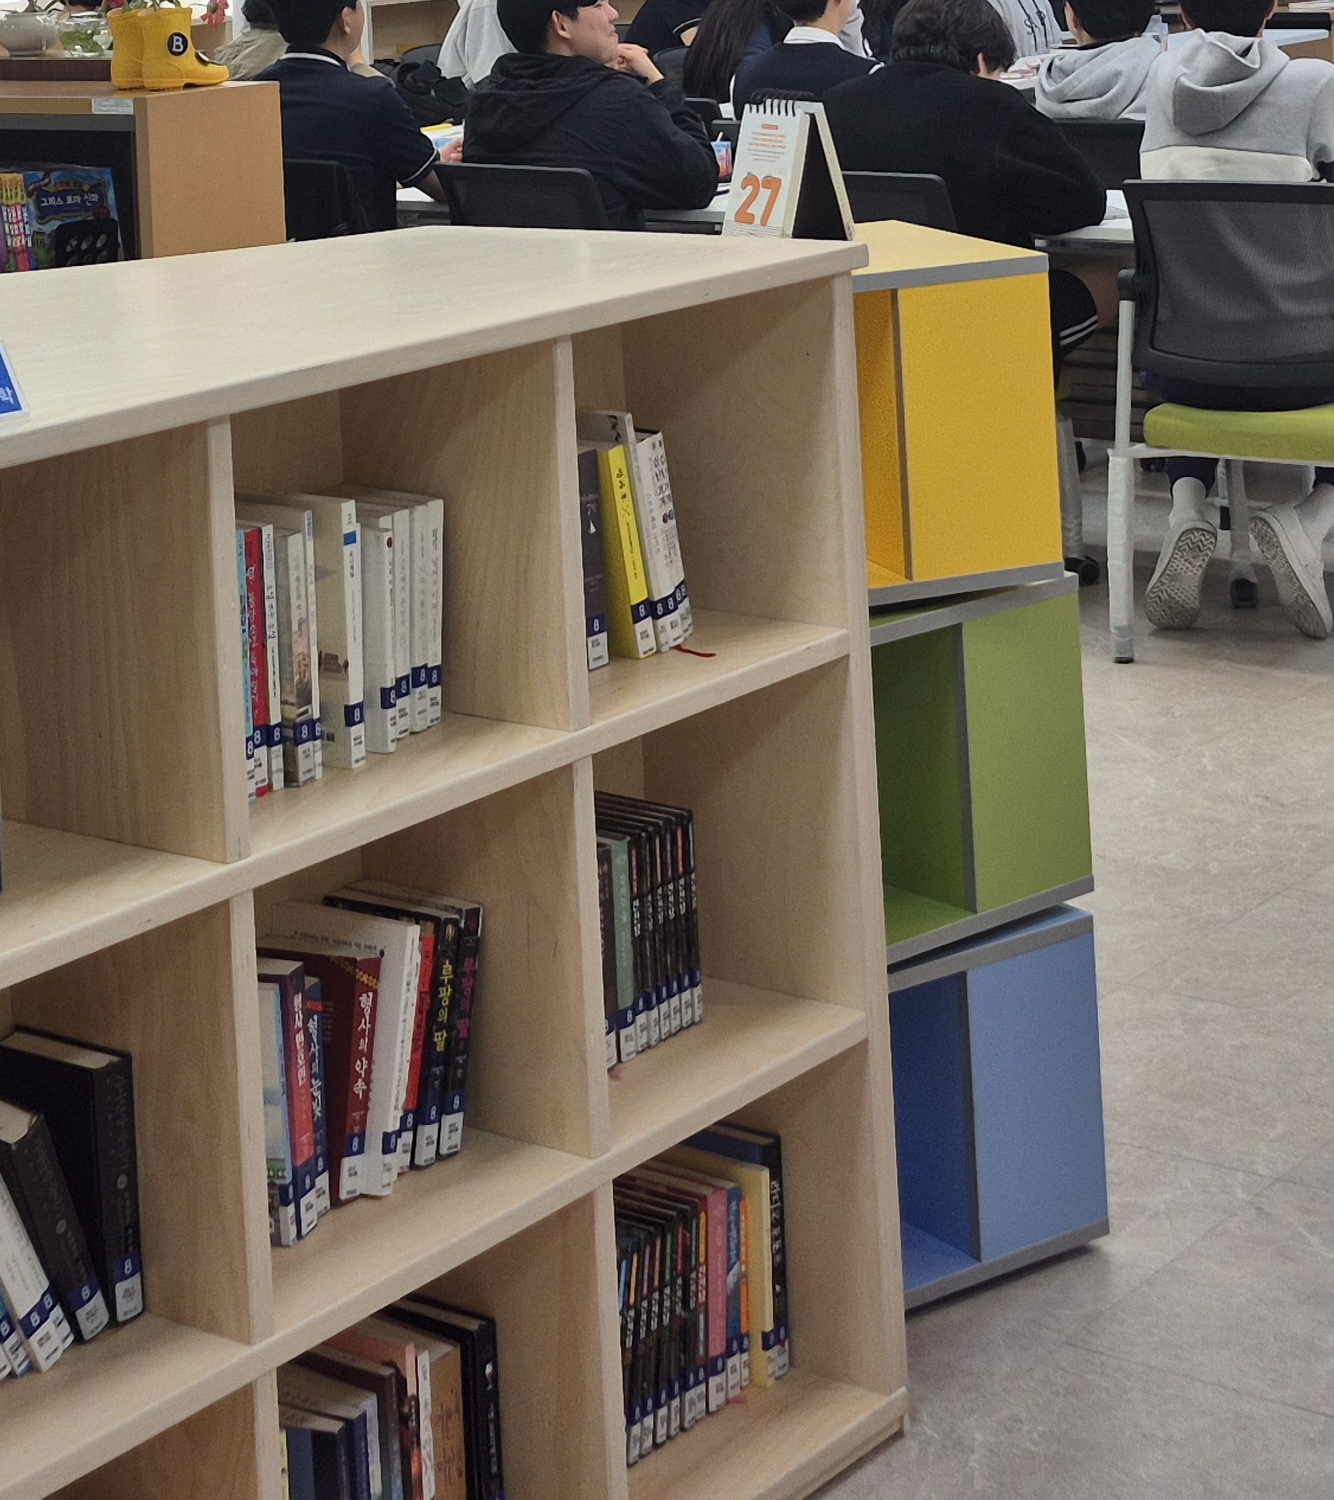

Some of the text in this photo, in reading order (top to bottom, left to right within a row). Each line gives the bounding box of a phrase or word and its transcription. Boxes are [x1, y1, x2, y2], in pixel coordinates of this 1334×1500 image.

[172, 35, 184, 52] B
[734, 174, 783, 227] 27
[638, 604, 645, 617] 8
[657, 602, 664, 615] 8
[593, 618, 600, 632] 8
[420, 668, 426, 682] 8
[432, 669, 438, 683] 8
[354, 707, 361, 722] 8
[254, 730, 261, 744] 8
[273, 727, 281, 741] 8
[302, 724, 308, 740] 8
[247, 740, 254, 755] 8
[433, 959, 454, 1052] 루팡의 딸
[627, 1009, 633, 1023] 8
[352, 991, 374, 1101] 형사의 약속
[453, 1094, 460, 1109] 8
[407, 1112, 414, 1127] 8
[430, 1105, 436, 1121] 8
[352, 1136, 358, 1151] 8
[390, 1133, 396, 1148] 8
[318, 1156, 324, 1171] 8
[305, 1174, 311, 1187] 8
[124, 1258, 132, 1275] 8
[81, 1284, 91, 1301] 8
[43, 1293, 54, 1310] 8
[30, 1311, 41, 1328] 8
[0, 1320, 11, 1336] 8
